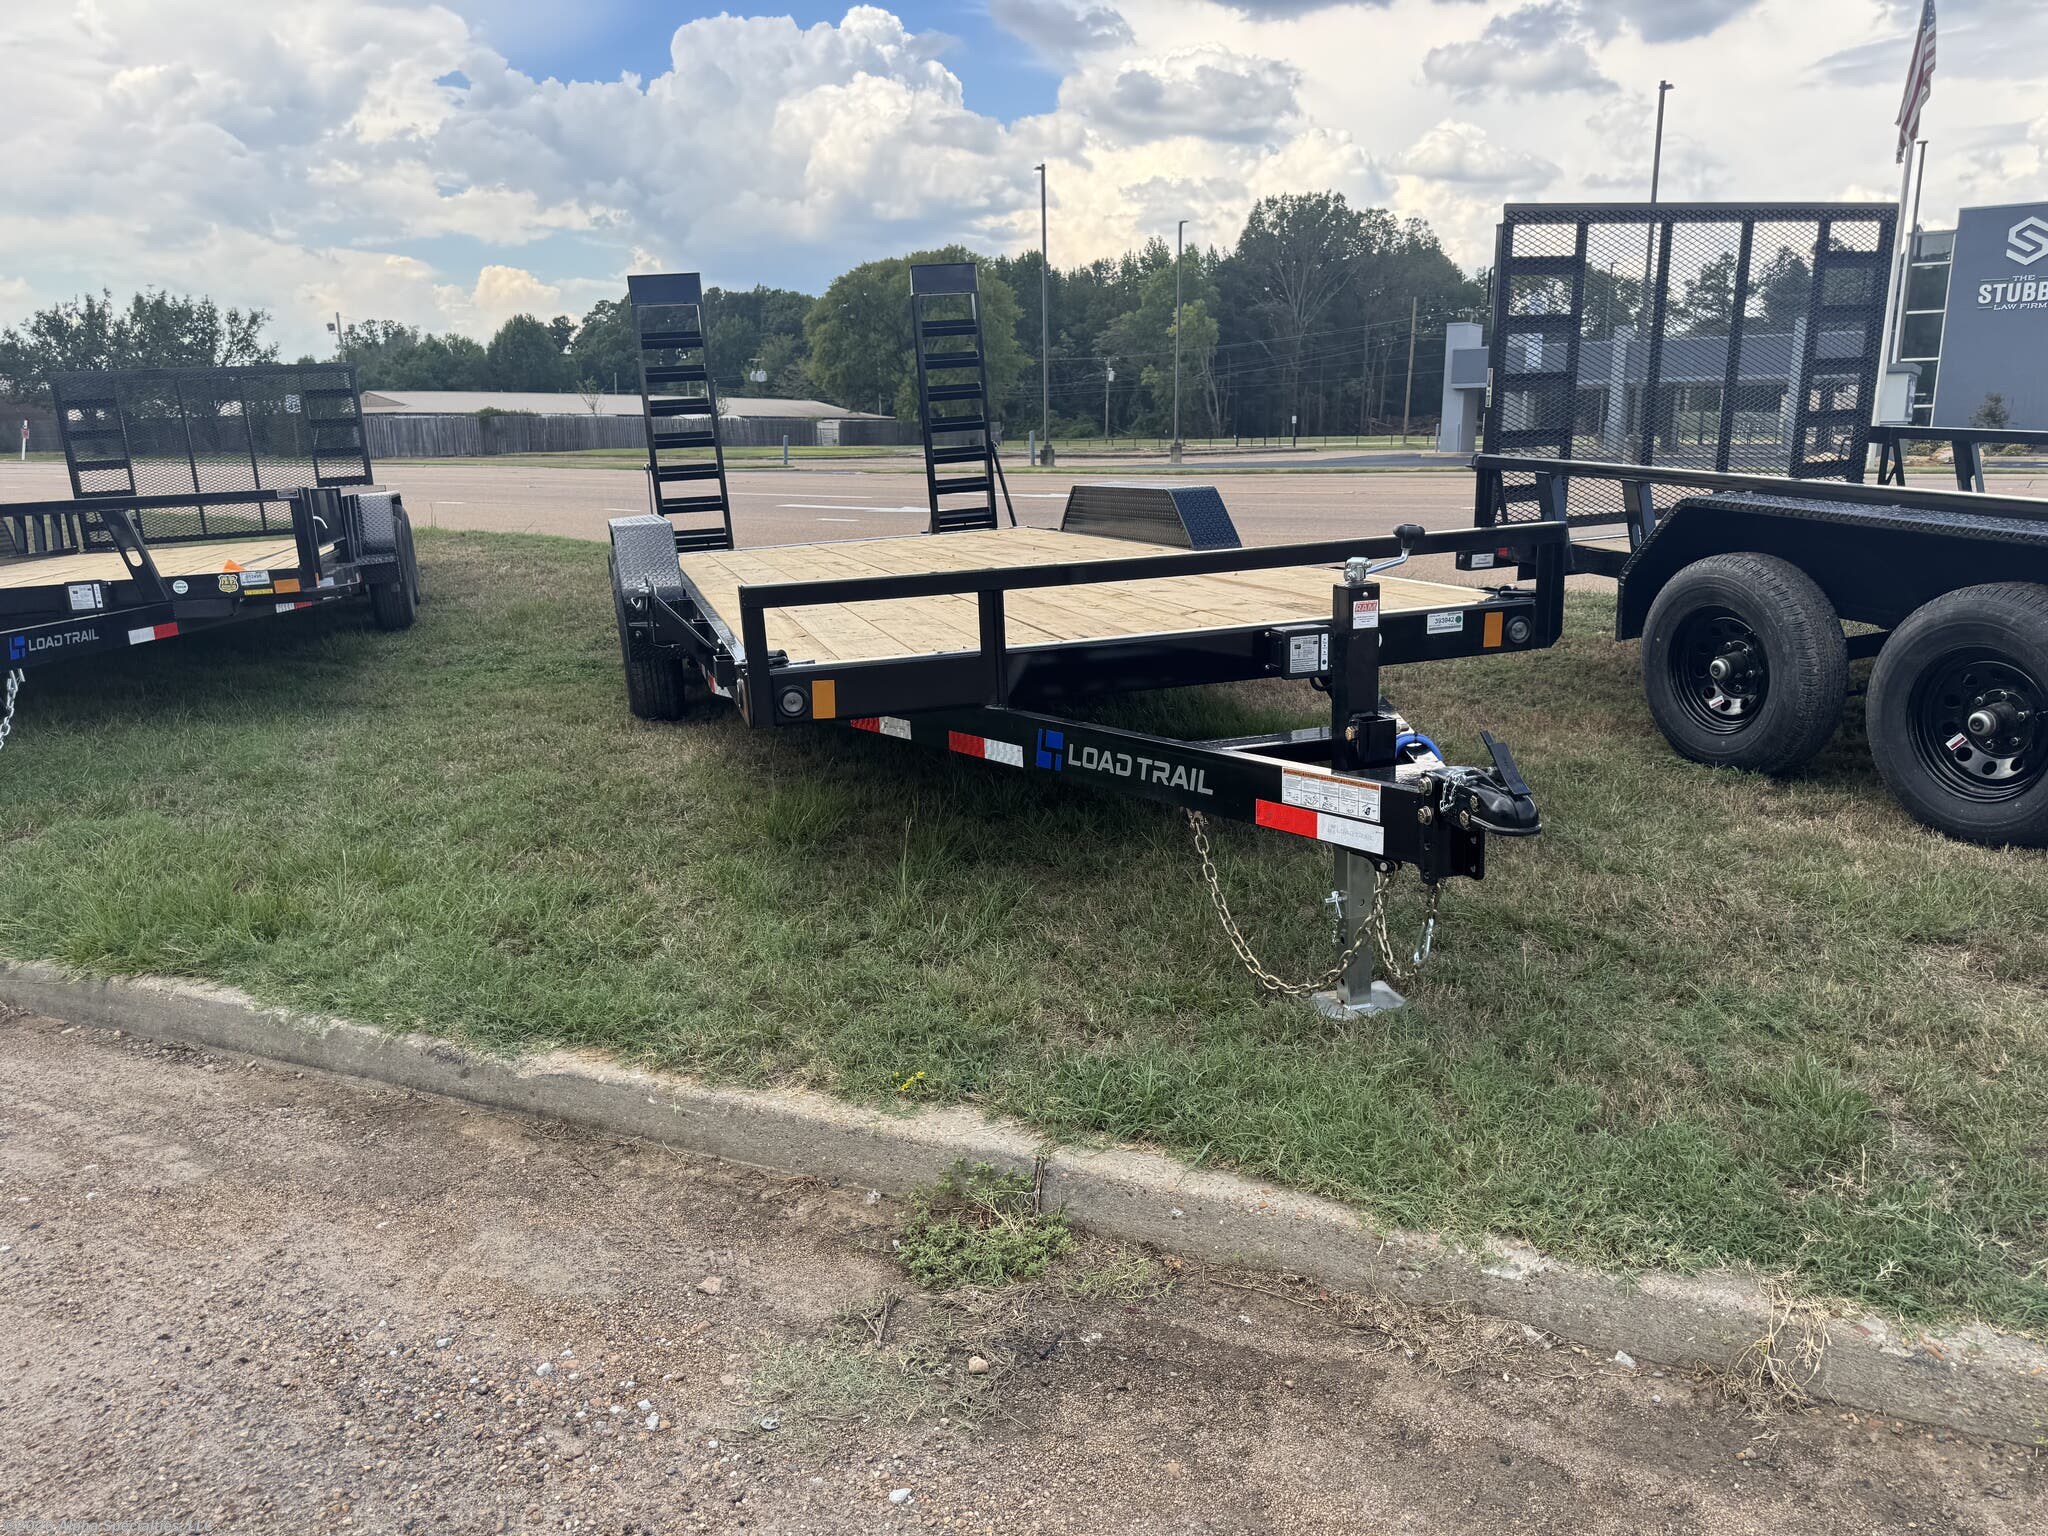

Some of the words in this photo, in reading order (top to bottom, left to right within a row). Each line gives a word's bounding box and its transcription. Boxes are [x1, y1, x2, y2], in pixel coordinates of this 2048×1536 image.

[28, 635, 63, 652] LOAD
[64, 628, 100, 645] TRAIL
[1068, 743, 1132, 777] LOAD
[1136, 756, 1214, 796] TRAIL
